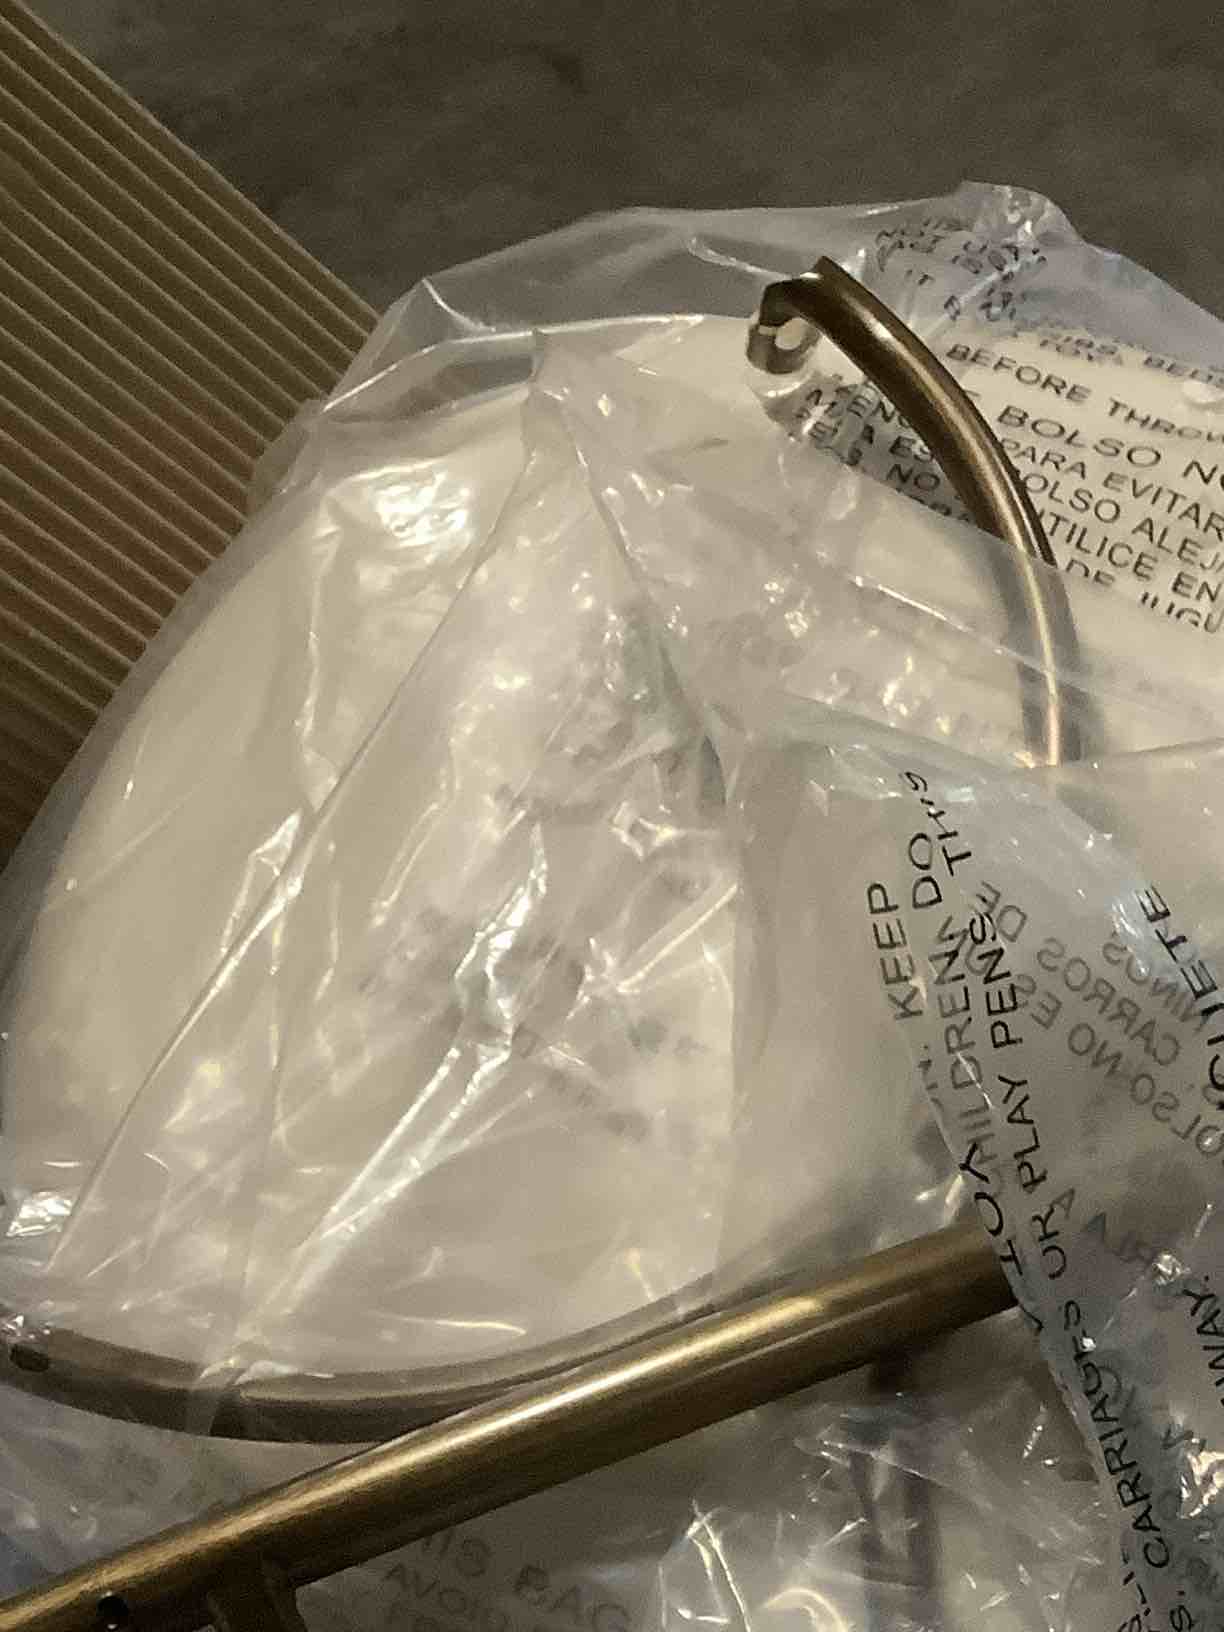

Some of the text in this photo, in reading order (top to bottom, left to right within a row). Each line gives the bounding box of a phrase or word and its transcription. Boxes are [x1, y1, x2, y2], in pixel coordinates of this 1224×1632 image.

[945, 343, 1093, 404] BEFORE
[997, 405, 1161, 468] BOLSO
[1000, 438, 1087, 480] PARA
[1021, 473, 1121, 523] OLSO
[1172, 572, 1223, 602] EN
[908, 833, 942, 909] DO
[867, 883, 923, 1020] KEEP
[998, 1074, 1048, 1190] PLAY
